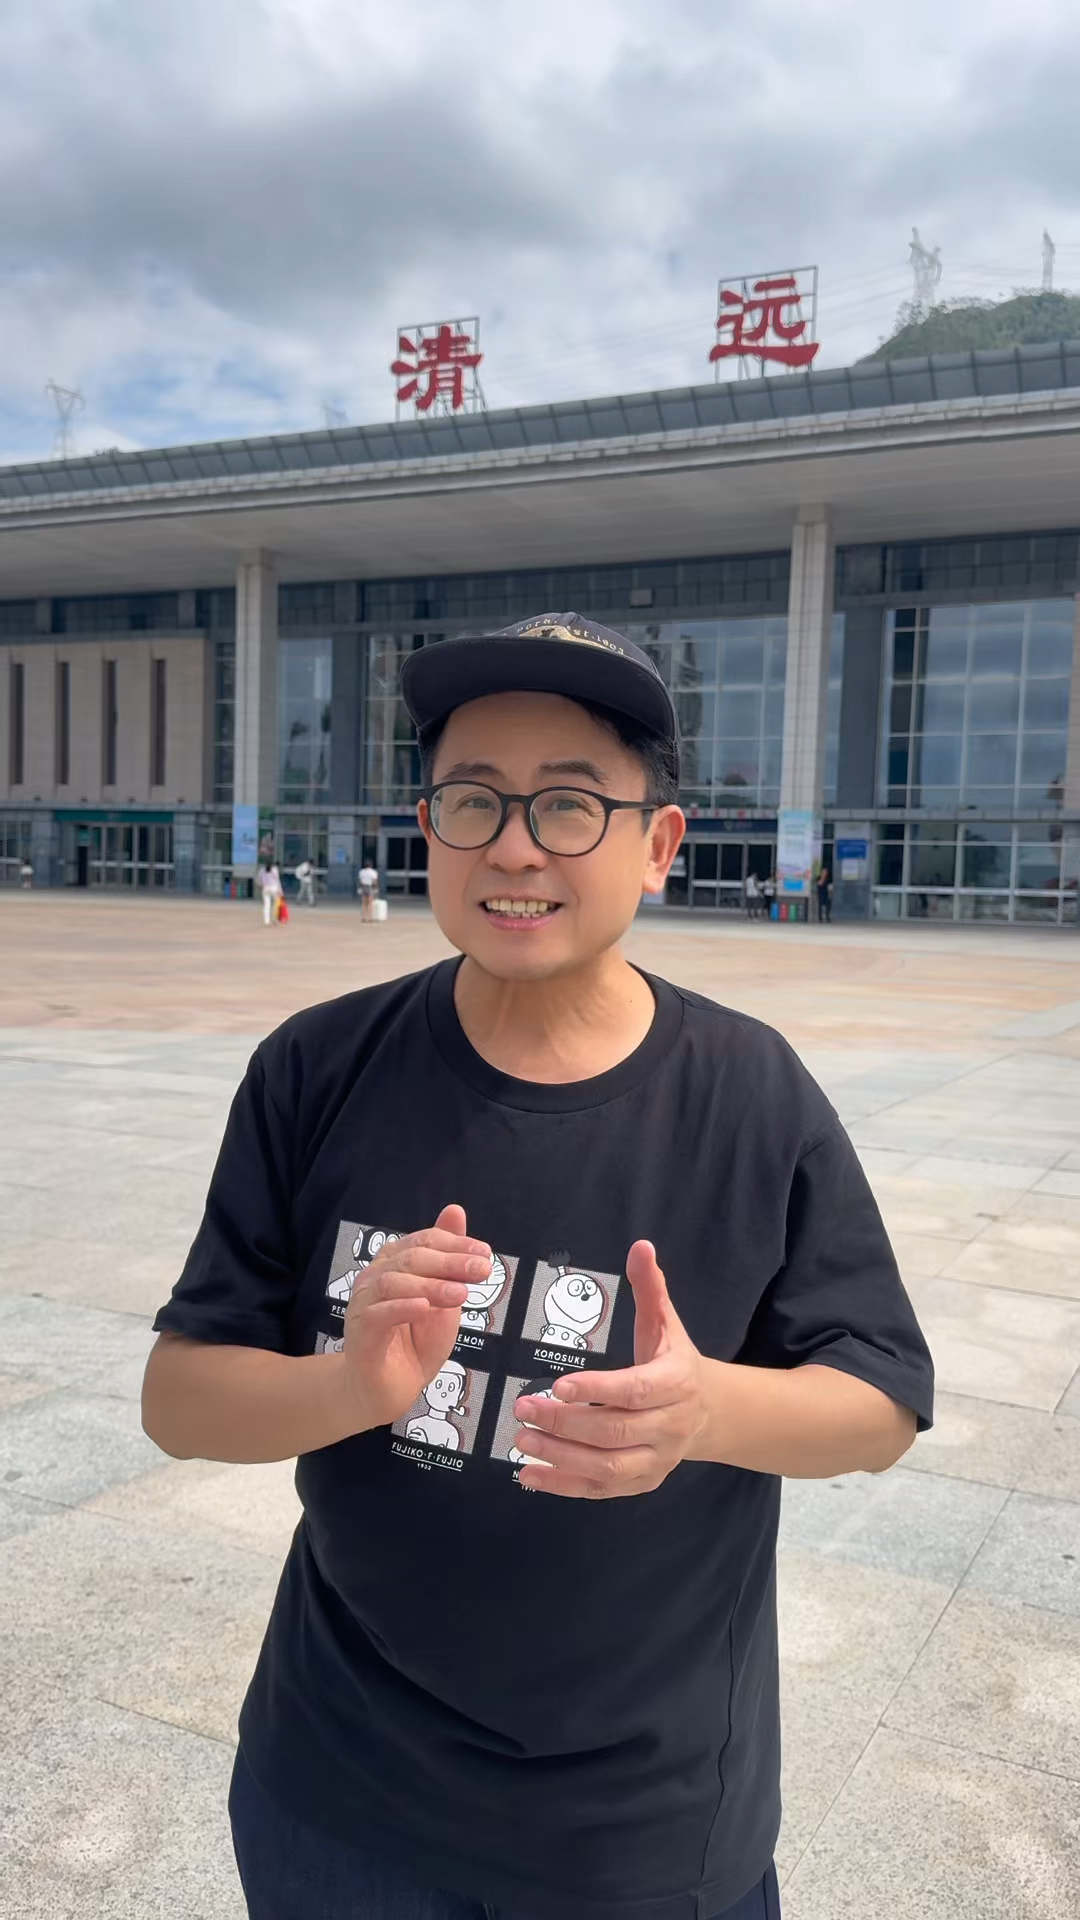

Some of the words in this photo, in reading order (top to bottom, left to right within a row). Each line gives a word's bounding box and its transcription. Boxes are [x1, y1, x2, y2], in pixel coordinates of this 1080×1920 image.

[391, 276, 820, 410] 清远
[331, 1304, 346, 1316] PER
[457, 1333, 485, 1347] EMON
[534, 1348, 586, 1366] KOROSUKE
